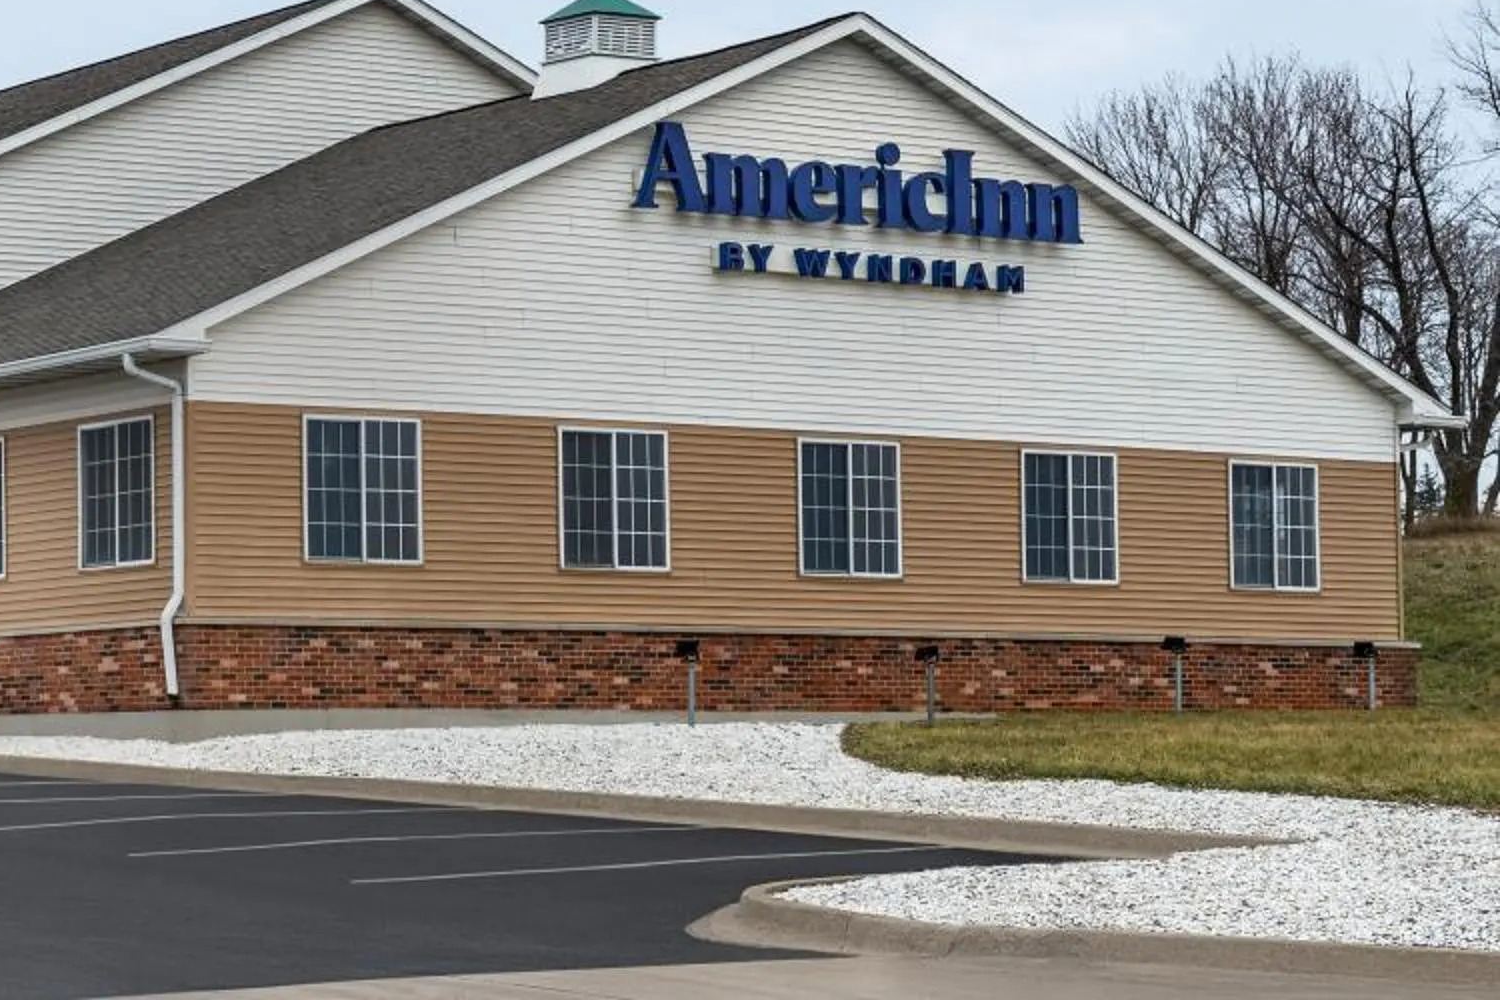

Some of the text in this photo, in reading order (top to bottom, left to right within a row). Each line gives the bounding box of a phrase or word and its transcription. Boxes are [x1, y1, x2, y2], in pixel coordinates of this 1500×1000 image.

[631, 121, 1084, 244] AmericInn
[718, 241, 1026, 294] BY WYNDHAM
